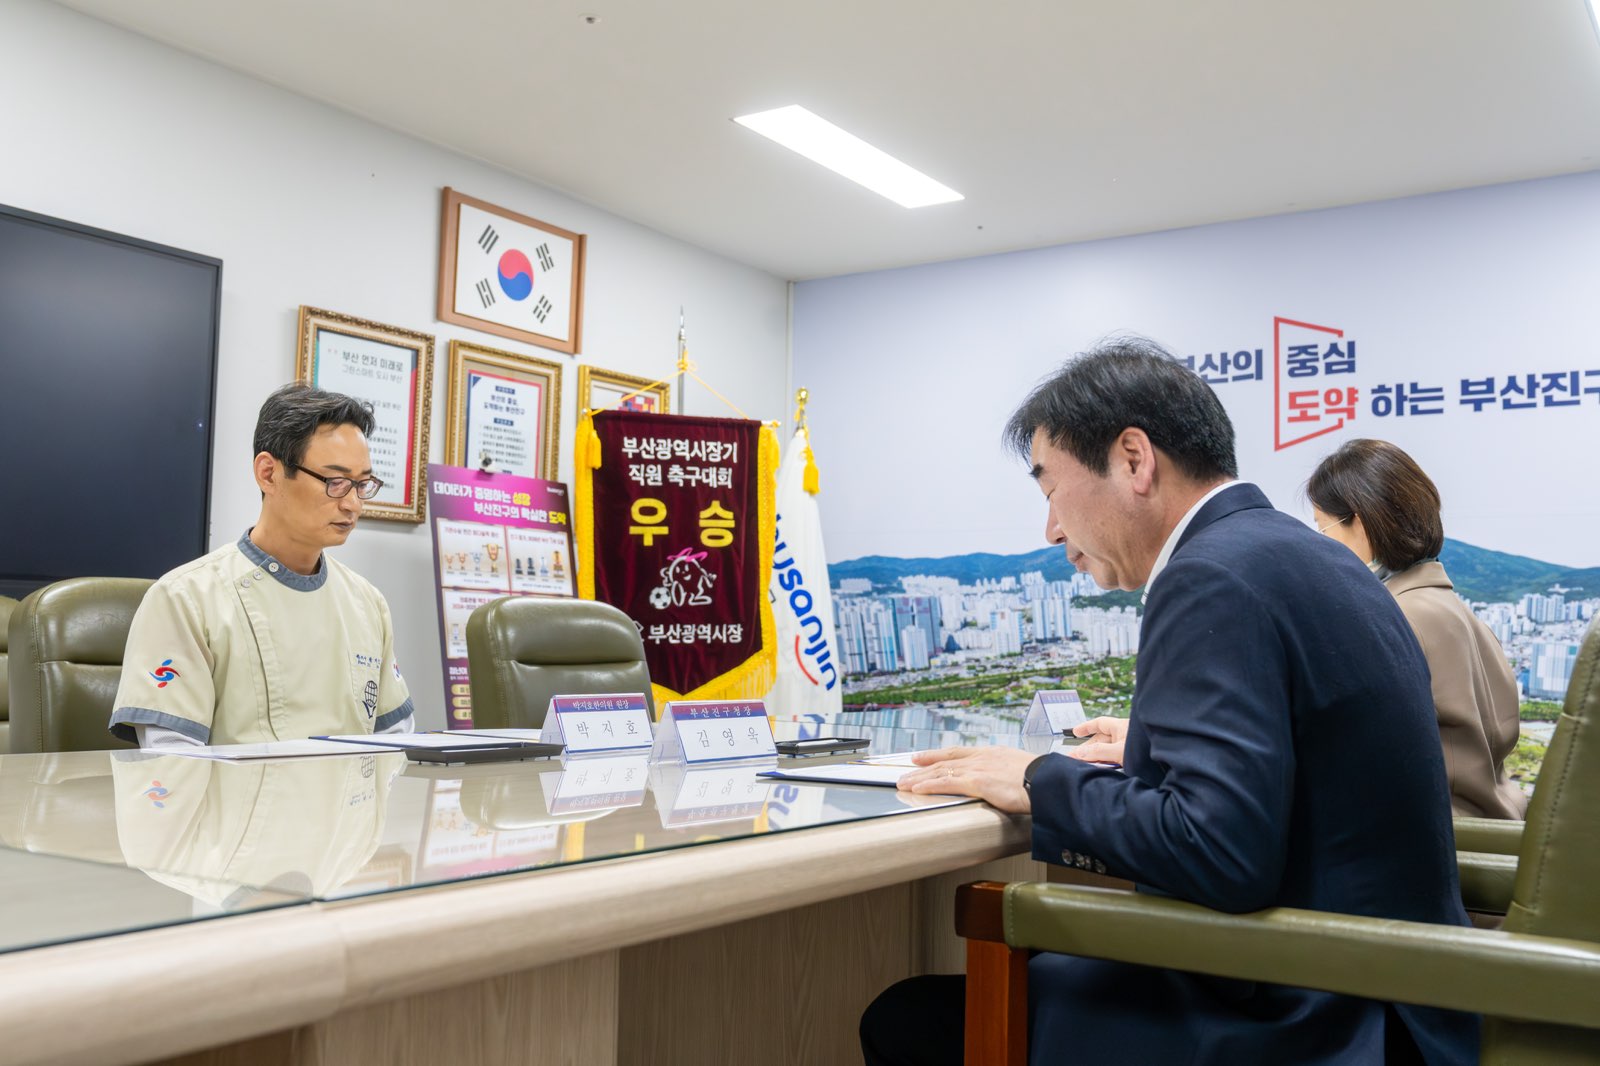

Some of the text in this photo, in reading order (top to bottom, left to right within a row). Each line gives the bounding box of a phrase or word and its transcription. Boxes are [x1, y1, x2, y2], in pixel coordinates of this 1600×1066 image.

[342, 351, 404, 372] 부산 먼저 미래로
[1177, 341, 1356, 384] 산의 중심
[1287, 387, 1359, 423] 도약
[1371, 382, 1444, 417] 하는
[622, 436, 738, 463] 부산광역시장기
[628, 463, 732, 489] 직원 축구대회
[433, 481, 473, 498] 데이터가
[474, 486, 511, 504] 증명하는
[474, 501, 520, 519] 부산진구의
[548, 511, 567, 525] 도약
[772, 513, 837, 691] usanjin
[648, 623, 743, 644] 부산광역시장
[572, 699, 629, 711] 박지호한의원 원장
[690, 705, 752, 718] 부산진구청장
